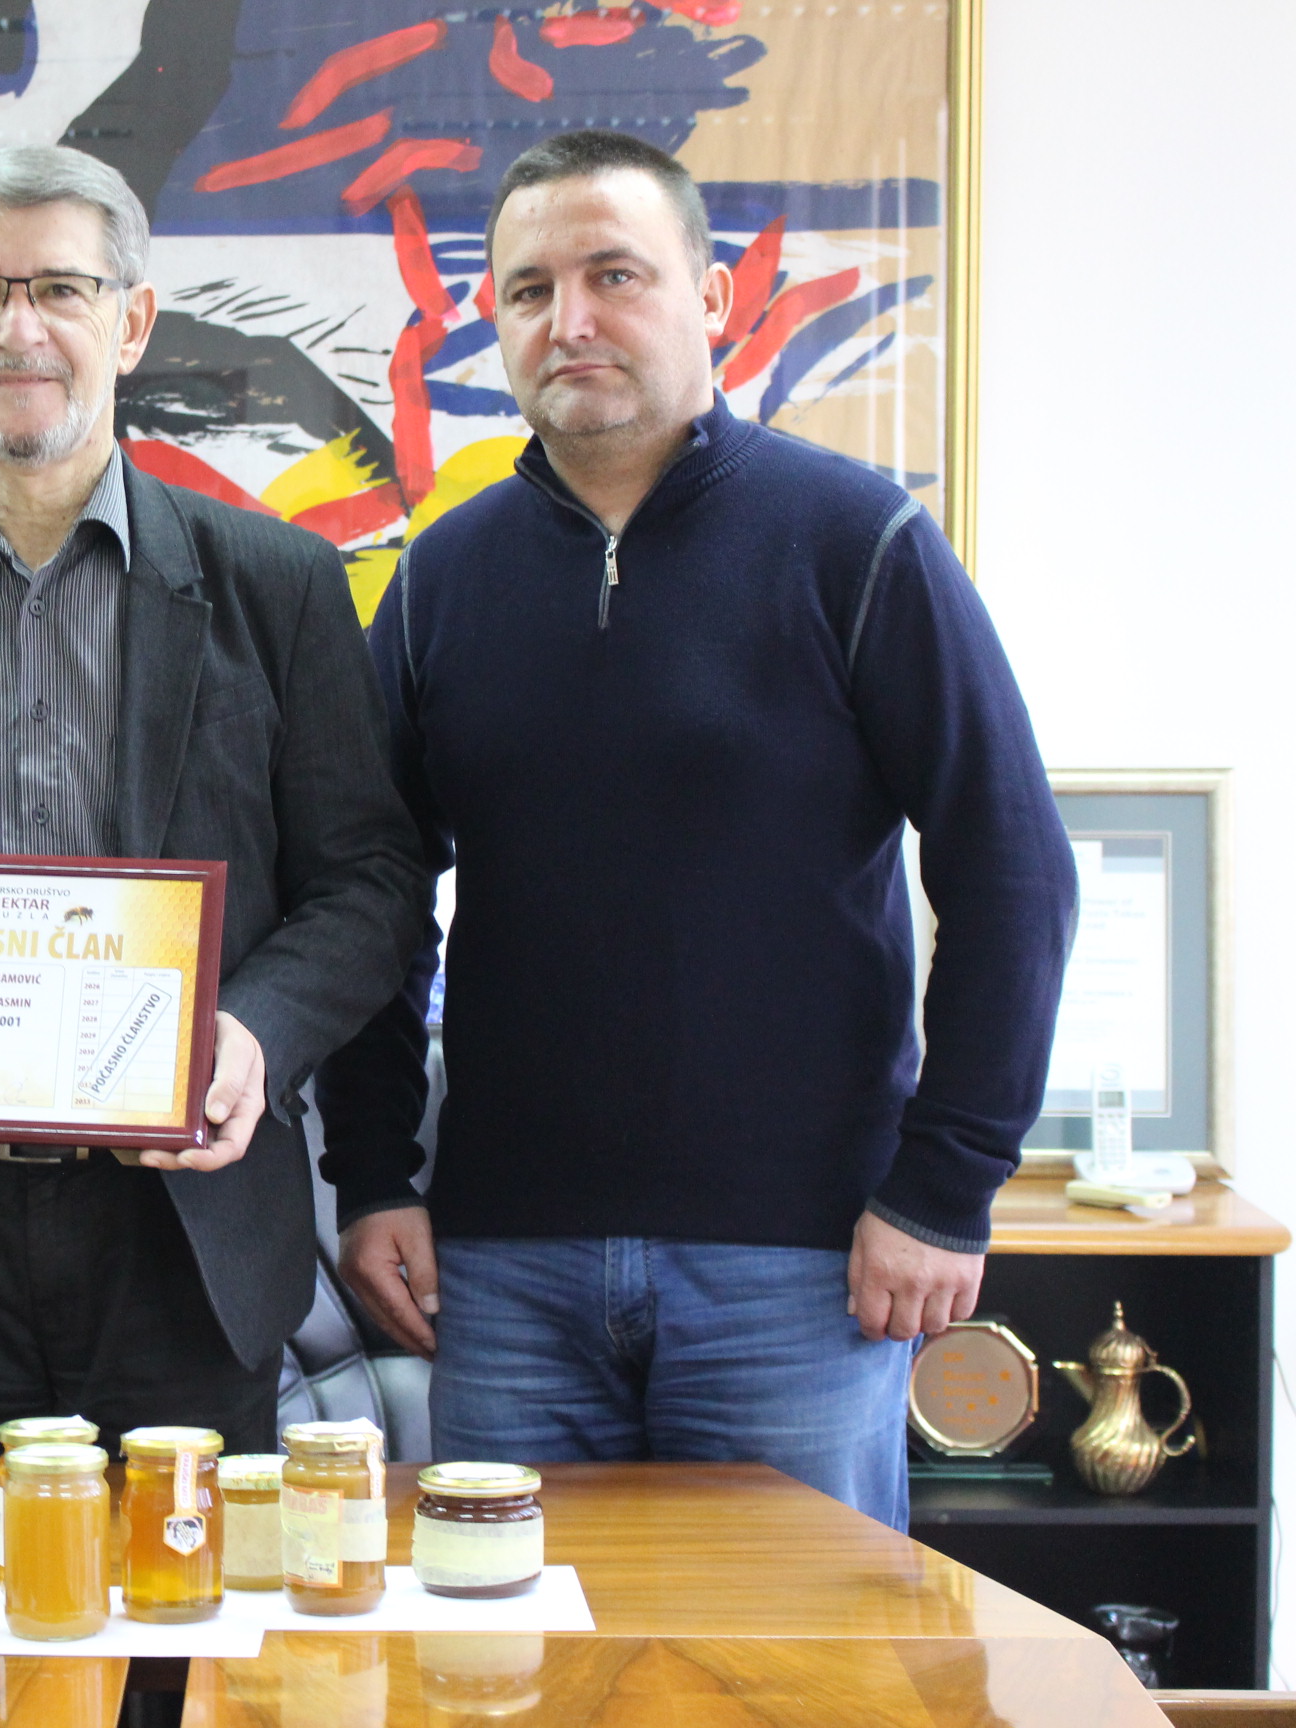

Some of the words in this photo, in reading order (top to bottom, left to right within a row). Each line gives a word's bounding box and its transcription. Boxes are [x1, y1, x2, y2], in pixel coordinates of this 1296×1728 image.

[26, 886, 71, 898] DRUŠTVO
[48, 926, 124, 961] ČLAN
[0, 1016, 21, 1028] 001
